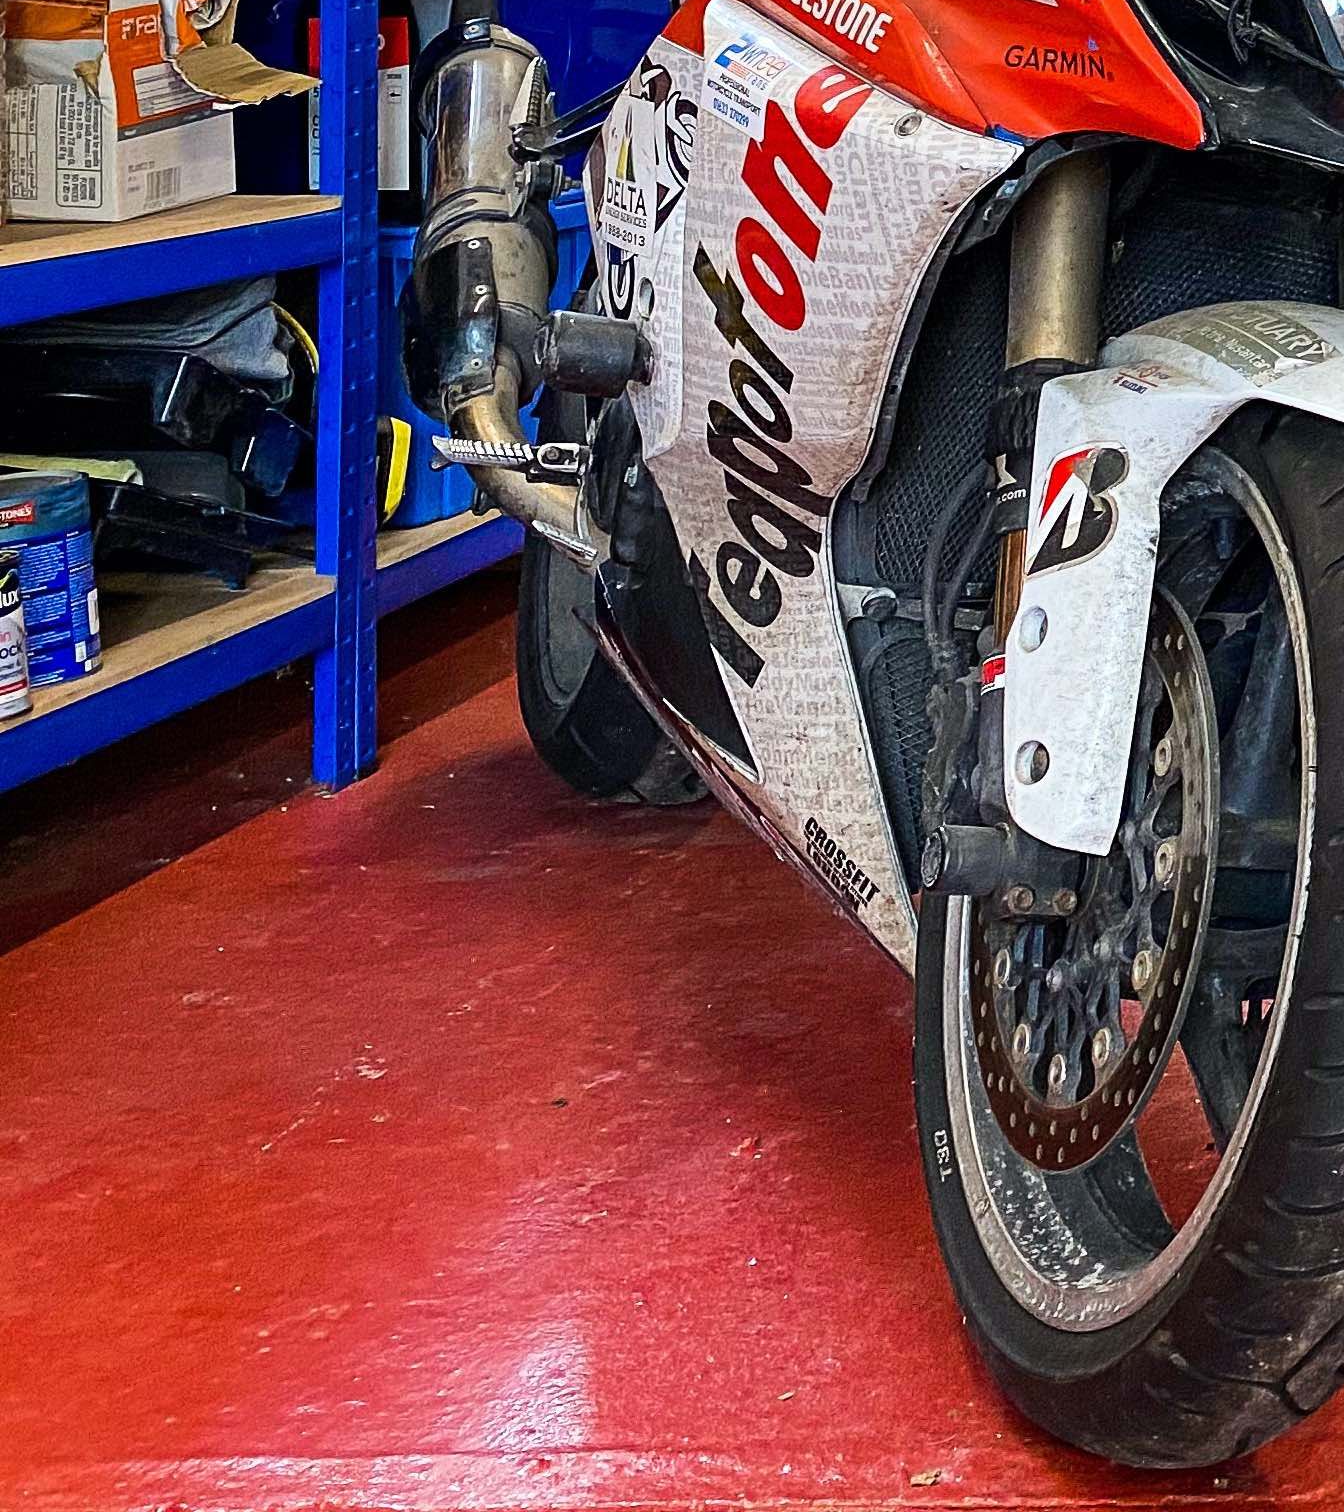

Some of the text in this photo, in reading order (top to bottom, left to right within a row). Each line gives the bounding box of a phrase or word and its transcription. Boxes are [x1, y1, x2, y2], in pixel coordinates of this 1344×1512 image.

[1004, 44, 1110, 80] GARMIN
[606, 175, 648, 217] DELTA
[689, 65, 875, 688] teapotone
[805, 816, 881, 904] CROSSFIT
